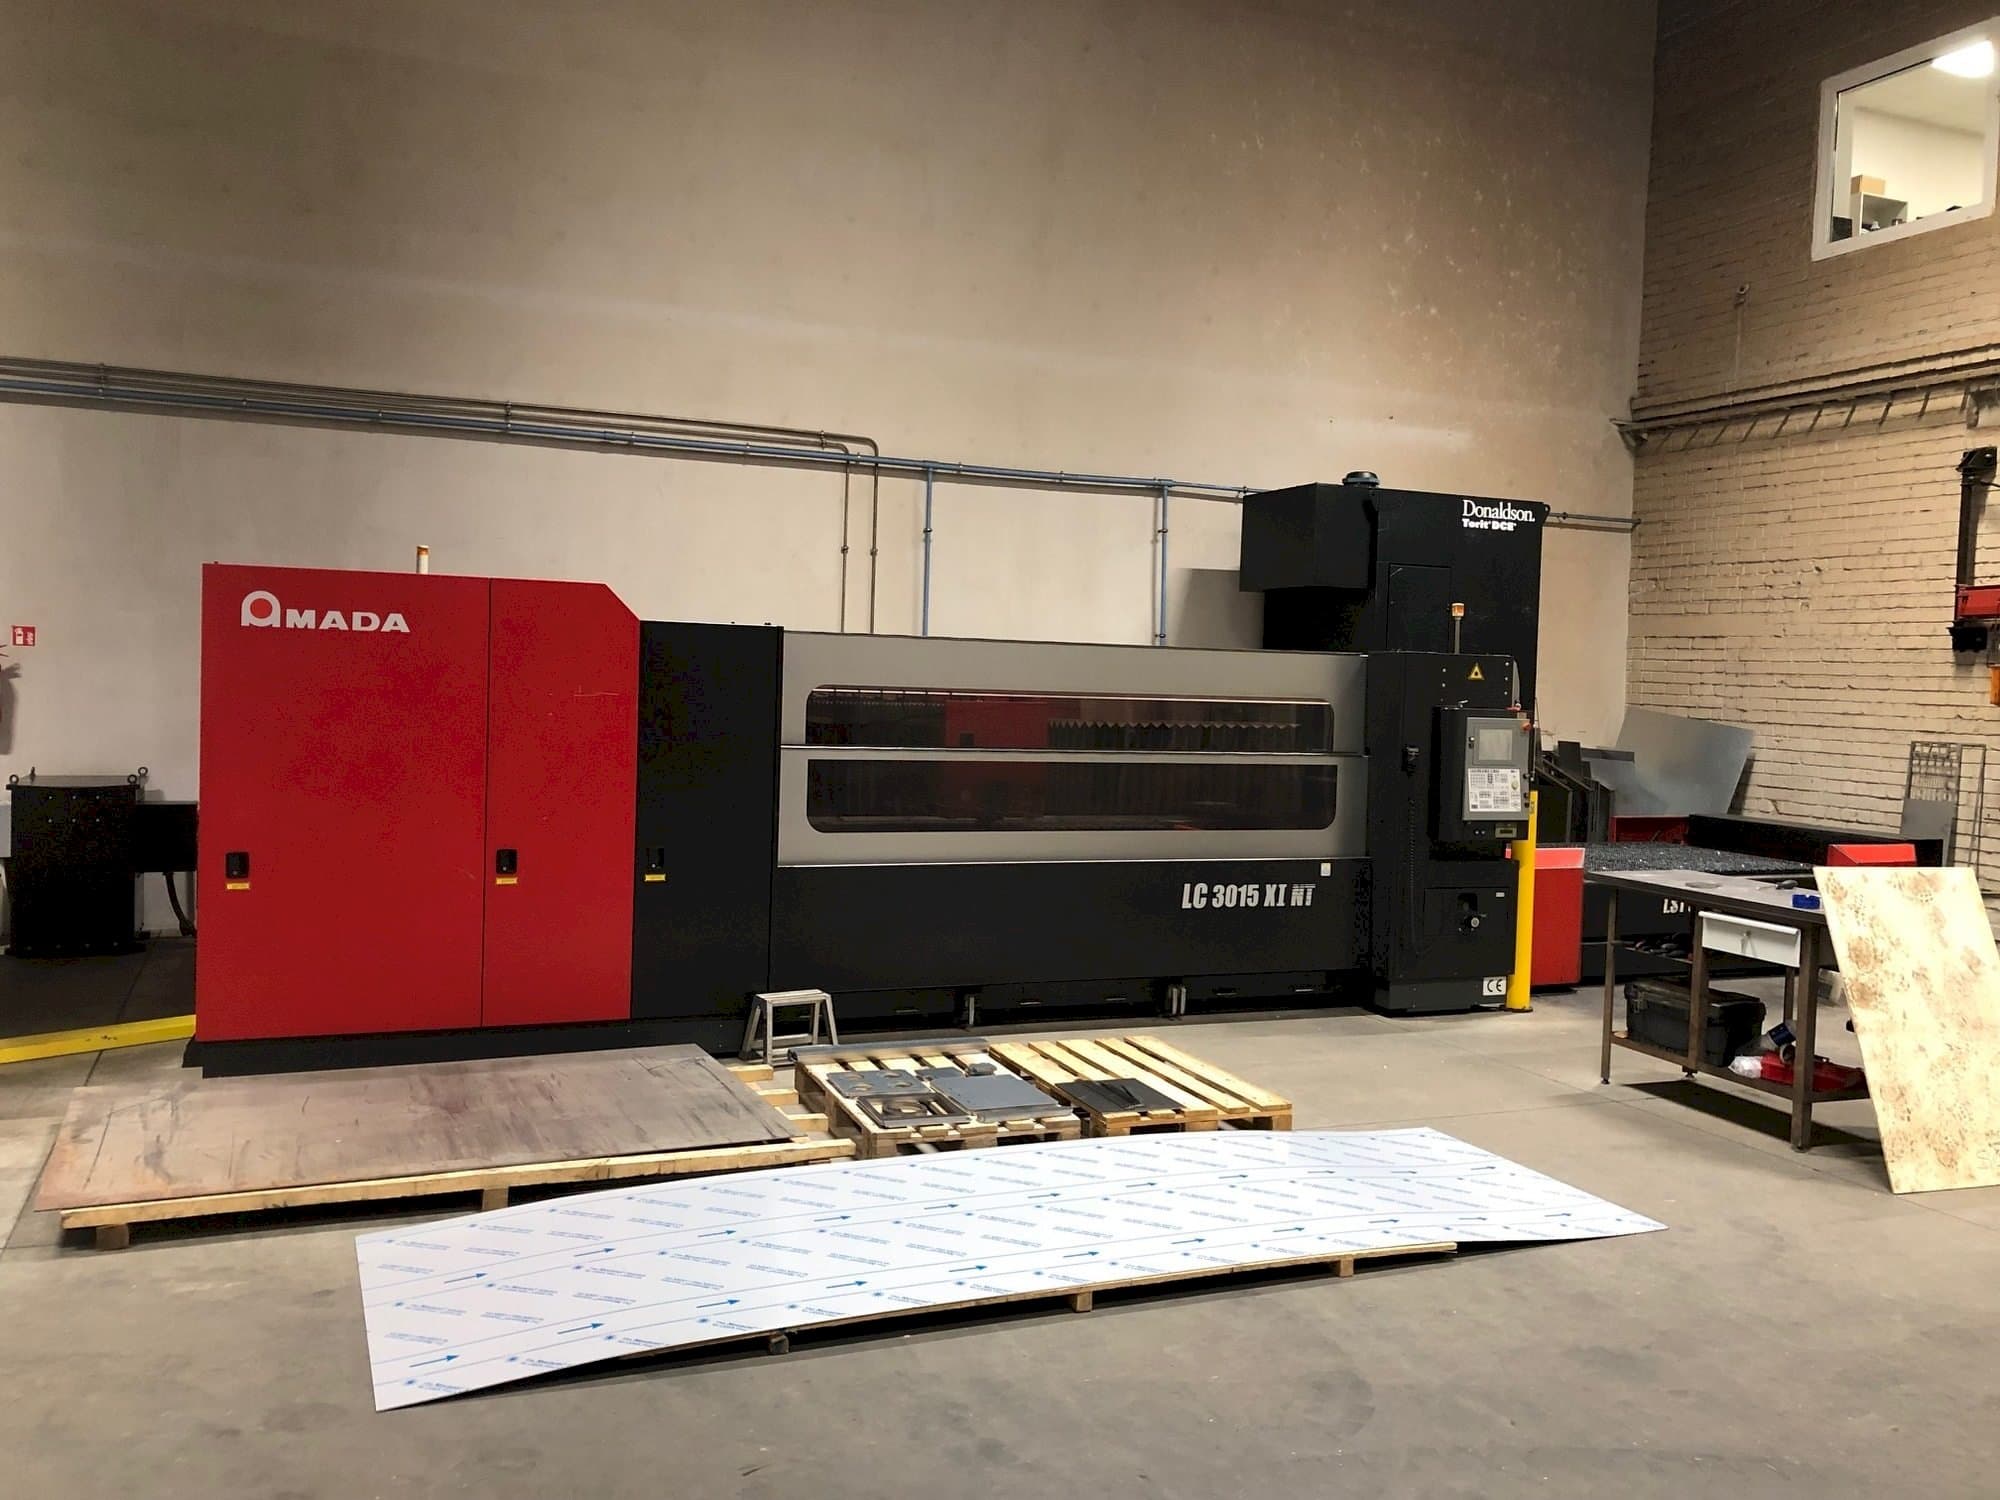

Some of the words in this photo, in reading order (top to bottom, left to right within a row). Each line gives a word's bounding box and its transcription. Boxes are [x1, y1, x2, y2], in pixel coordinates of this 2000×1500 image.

[241, 590, 411, 633] AMADA
[1182, 883, 1208, 909] LC
[1212, 884, 1260, 908] 3015
[1290, 884, 1316, 907] NT
[1487, 979, 1503, 993] CE
